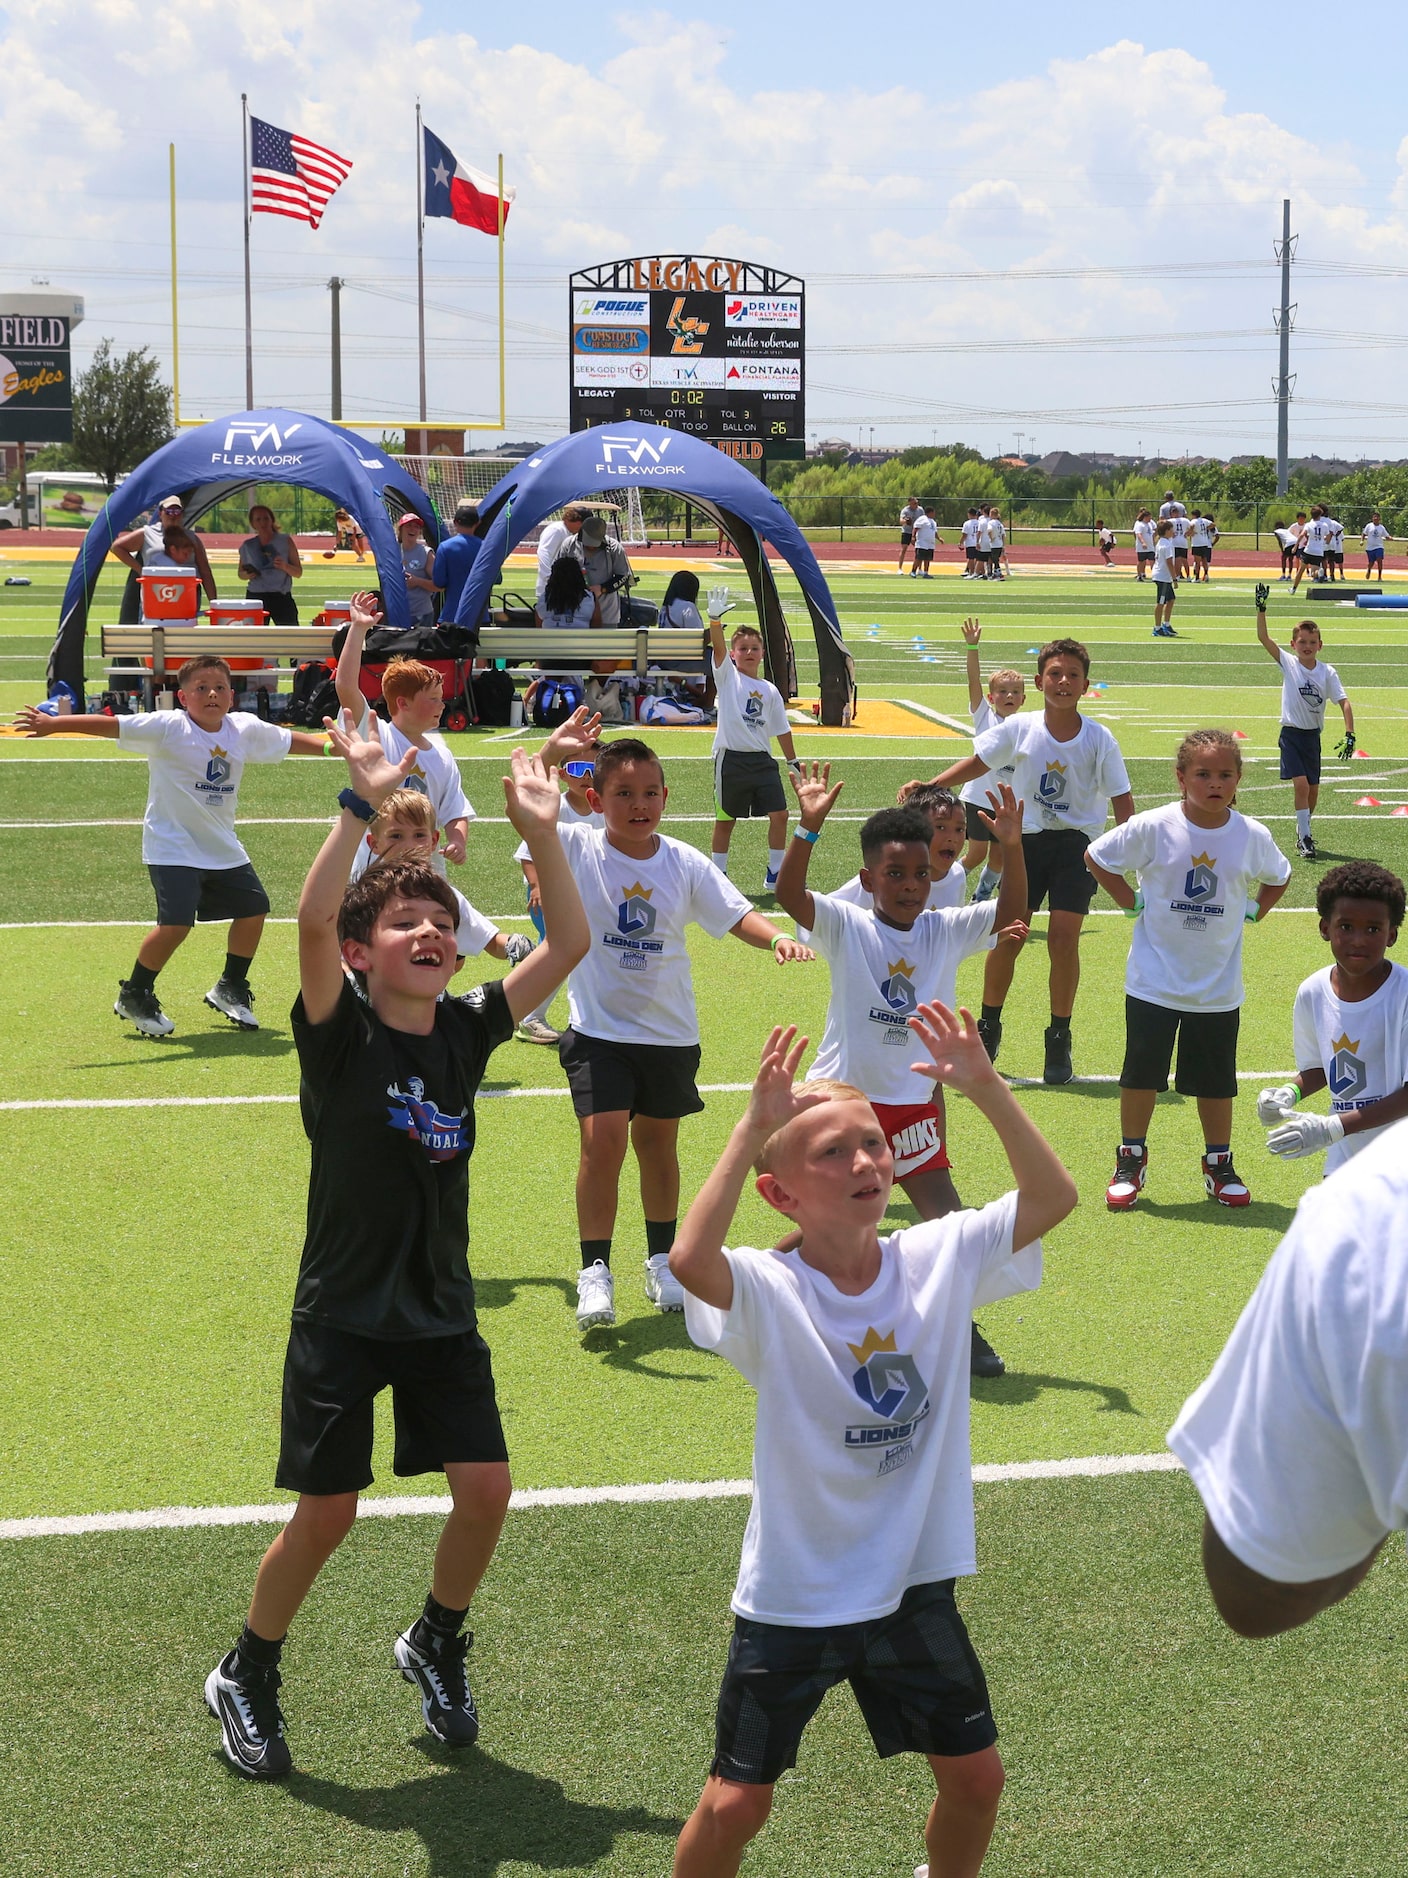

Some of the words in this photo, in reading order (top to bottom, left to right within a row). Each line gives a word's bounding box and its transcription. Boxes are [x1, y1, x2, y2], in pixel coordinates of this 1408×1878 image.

[633, 260, 742, 292] LEGACY
[594, 300, 648, 311] POGUE
[749, 302, 798, 311] DRIVEN
[0, 317, 65, 346] FIELD
[583, 330, 639, 348] COMSTOCK
[727, 332, 759, 348] natalie
[760, 332, 799, 348] roberson
[742, 366, 798, 374] FONTANA
[4, 368, 65, 396] Eagles
[578, 389, 616, 398] LEGACY
[672, 390, 704, 404] 0:02
[626, 408, 630, 417] 3
[639, 409, 654, 417] TOL
[665, 410, 686, 418] QTR
[721, 410, 736, 418] TOL
[744, 410, 750, 419] 3
[682, 422, 694, 430] TO
[695, 423, 708, 431] GO
[723, 423, 742, 431] BALL
[744, 424, 756, 432] ON
[771, 422, 786, 434] 26
[212, 453, 303, 466] FLEXWORK
[596, 464, 686, 475] FLEXWORK
[162, 587, 173, 598] G
[195, 783, 220, 791] LIONS
[1170, 902, 1202, 912] LIONS
[1204, 906, 1224, 914] DEN
[603, 935, 640, 949] LIONS
[641, 942, 664, 951] DEN
[870, 1010, 906, 1024] LIONS
[892, 1118, 938, 1156] NIKE
[845, 1423, 912, 1444] LIONS
